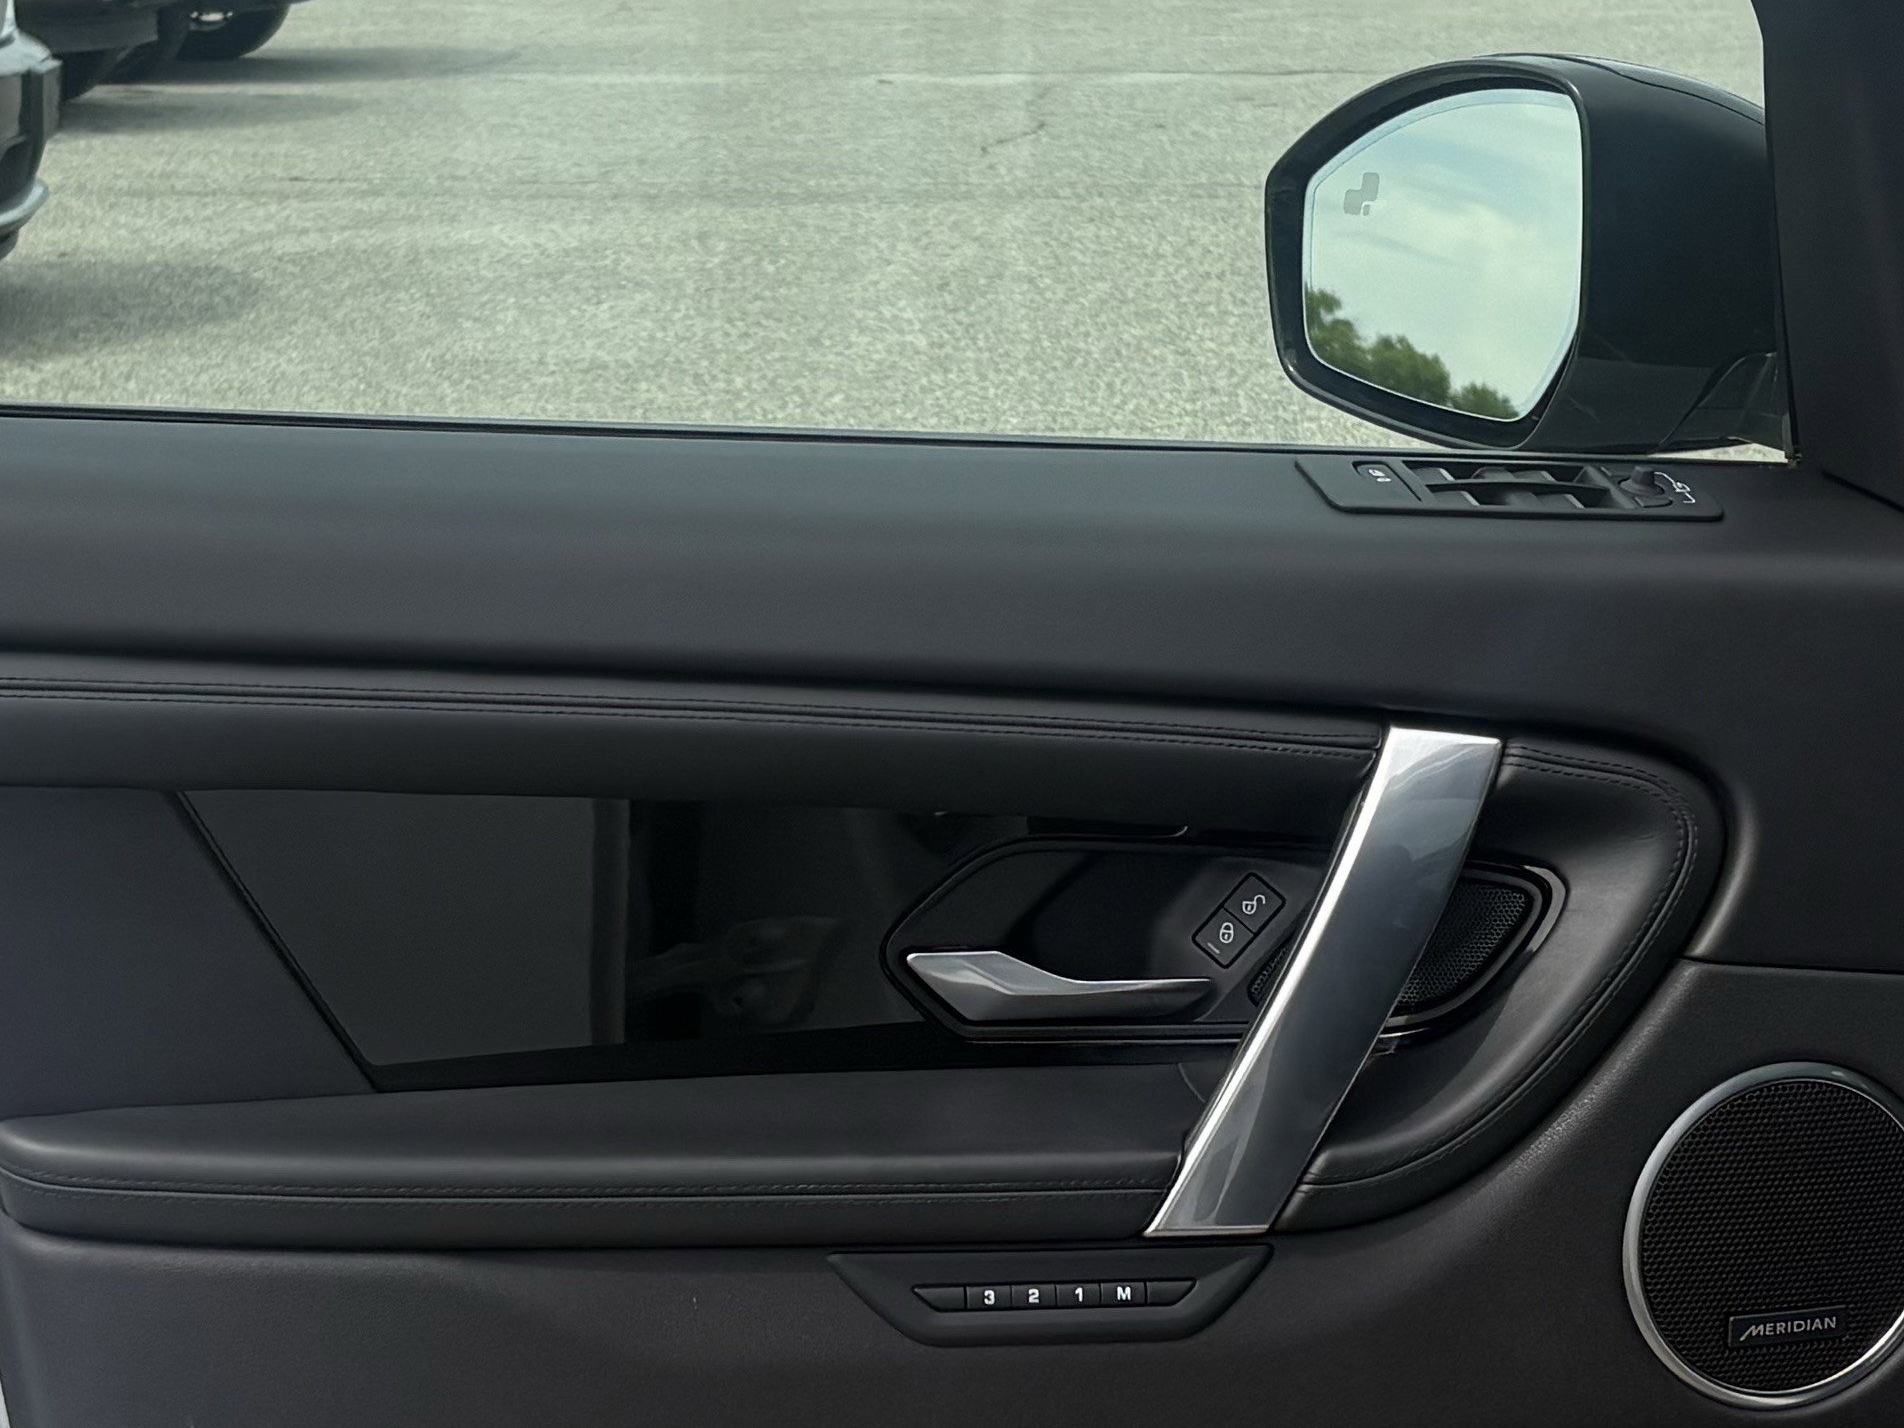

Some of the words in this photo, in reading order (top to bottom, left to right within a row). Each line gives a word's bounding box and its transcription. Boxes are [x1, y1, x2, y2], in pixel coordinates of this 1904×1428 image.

[983, 1289, 995, 1305] 3
[1028, 1288, 1040, 1304] 2
[1074, 1287, 1084, 1302] 1
[1116, 1286, 1131, 1301] M
[1739, 1316, 1837, 1342] MERIDIAN
